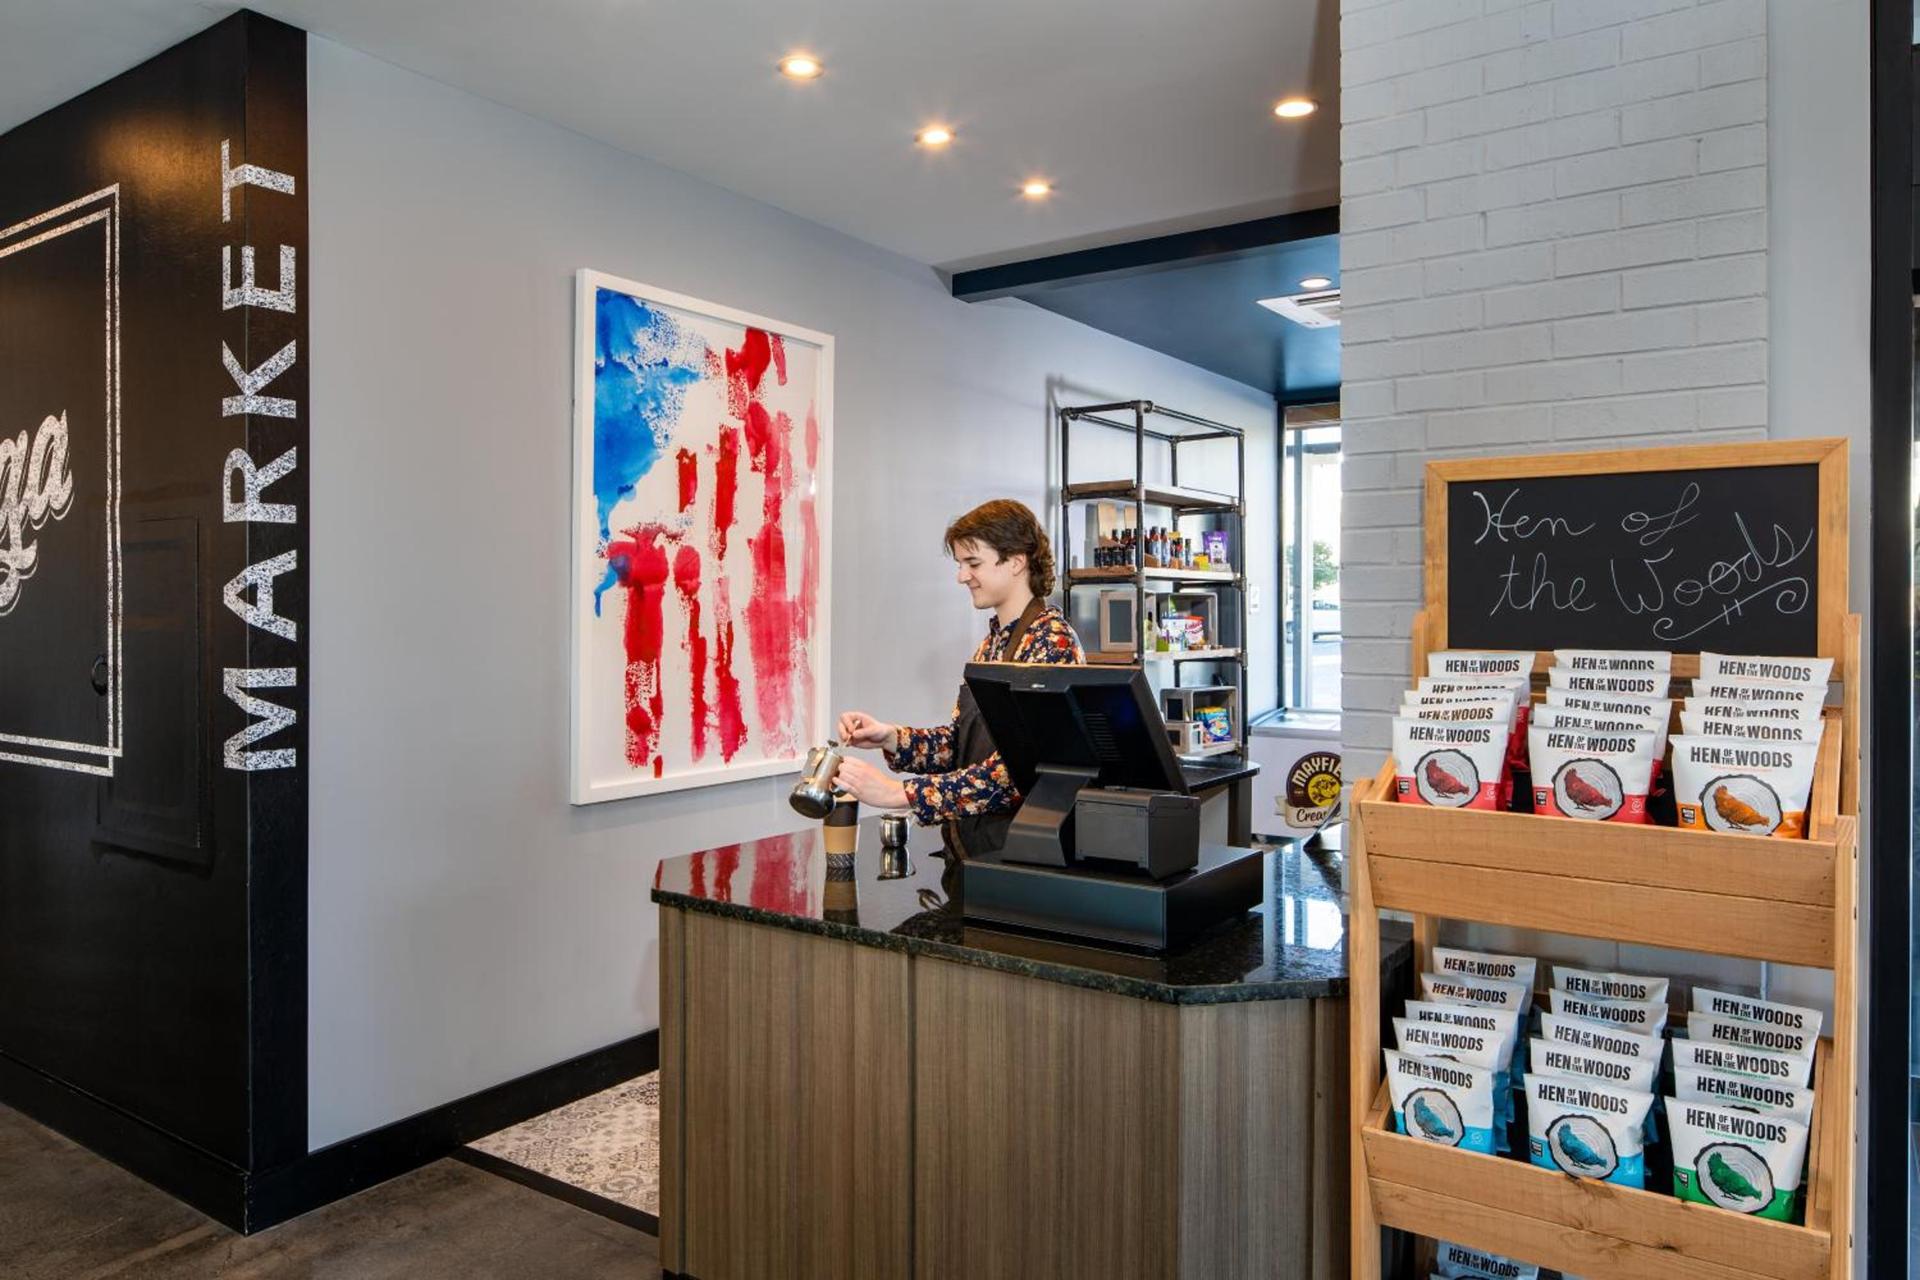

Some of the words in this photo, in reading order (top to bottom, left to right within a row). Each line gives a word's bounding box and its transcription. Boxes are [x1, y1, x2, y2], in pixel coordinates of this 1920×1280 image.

[222, 138, 297, 770] MARKET
[1472, 488, 1596, 545] Hen
[1621, 482, 1700, 546] of
[1490, 552, 1597, 616] the
[1610, 511, 1814, 614] Woods
[1446, 660, 1468, 672] HEN
[1480, 660, 1519, 672] WOODS
[1572, 658, 1596, 670] HEN
[1610, 659, 1654, 670] WOODS
[1719, 661, 1746, 676] HEN
[1760, 664, 1811, 681] WOODS
[1569, 677, 1594, 690] HEN
[1607, 678, 1654, 692] WOODS
[1711, 686, 1738, 699] HEN
[1752, 688, 1804, 701] WOODS
[1451, 708, 1493, 720] WOODS
[1565, 698, 1590, 710] HEN
[1555, 715, 1581, 728] HEN
[1704, 721, 1732, 736] HEN
[1747, 725, 1802, 740] WOODS
[1410, 726, 1434, 740] HEN
[1446, 728, 1490, 742] WOODS
[1547, 734, 1574, 748] HEN
[1587, 737, 1636, 753] WOODS
[1691, 746, 1720, 763] HEN
[1722, 758, 1734, 766] THE
[1724, 749, 1733, 757] OF
[1736, 750, 1792, 768] WOODS
[1444, 958, 1466, 972] HEN
[1477, 962, 1516, 977] WOODS
[1432, 983, 1455, 995] HEN
[1466, 987, 1507, 1004] WOODS
[1566, 976, 1590, 992] HEN
[1602, 981, 1646, 999] WOODS
[1419, 1010, 1442, 1022] HEN
[1563, 1000, 1587, 1016] HEN
[1600, 1007, 1645, 1024] WOODS
[1712, 998, 1739, 1015] HEN
[1752, 1006, 1803, 1029] WOODS
[1406, 1028, 1429, 1044] HEN
[1440, 1033, 1484, 1051] WOODS
[1554, 1025, 1580, 1044] HEN
[1581, 1040, 1592, 1048] THE
[1593, 1036, 1640, 1057] WOODS
[1712, 1024, 1739, 1041] HEN
[1753, 1030, 1803, 1051] WOODS
[1546, 1052, 1571, 1070] HEN
[1584, 1058, 1631, 1080] WOODS
[1694, 1048, 1722, 1066] HEN
[1724, 1060, 1736, 1069] THE
[1736, 1055, 1789, 1077] WOODS
[1399, 1058, 1421, 1077] HEN
[1432, 1066, 1473, 1089] WOODS
[1538, 1084, 1565, 1103] HEN
[1566, 1097, 1578, 1106] THE
[1578, 1090, 1628, 1114] WOODS
[1697, 1076, 1726, 1094] HEN
[1727, 1089, 1739, 1097] THE
[1740, 1083, 1794, 1108] WOODS
[1686, 1108, 1716, 1130] HEN
[1717, 1123, 1730, 1132] THE
[1719, 1114, 1728, 1123] OF
[1730, 1116, 1787, 1143] WOODS
[1449, 1247, 1471, 1266] HEN
[1480, 1256, 1520, 1277] WOODS
